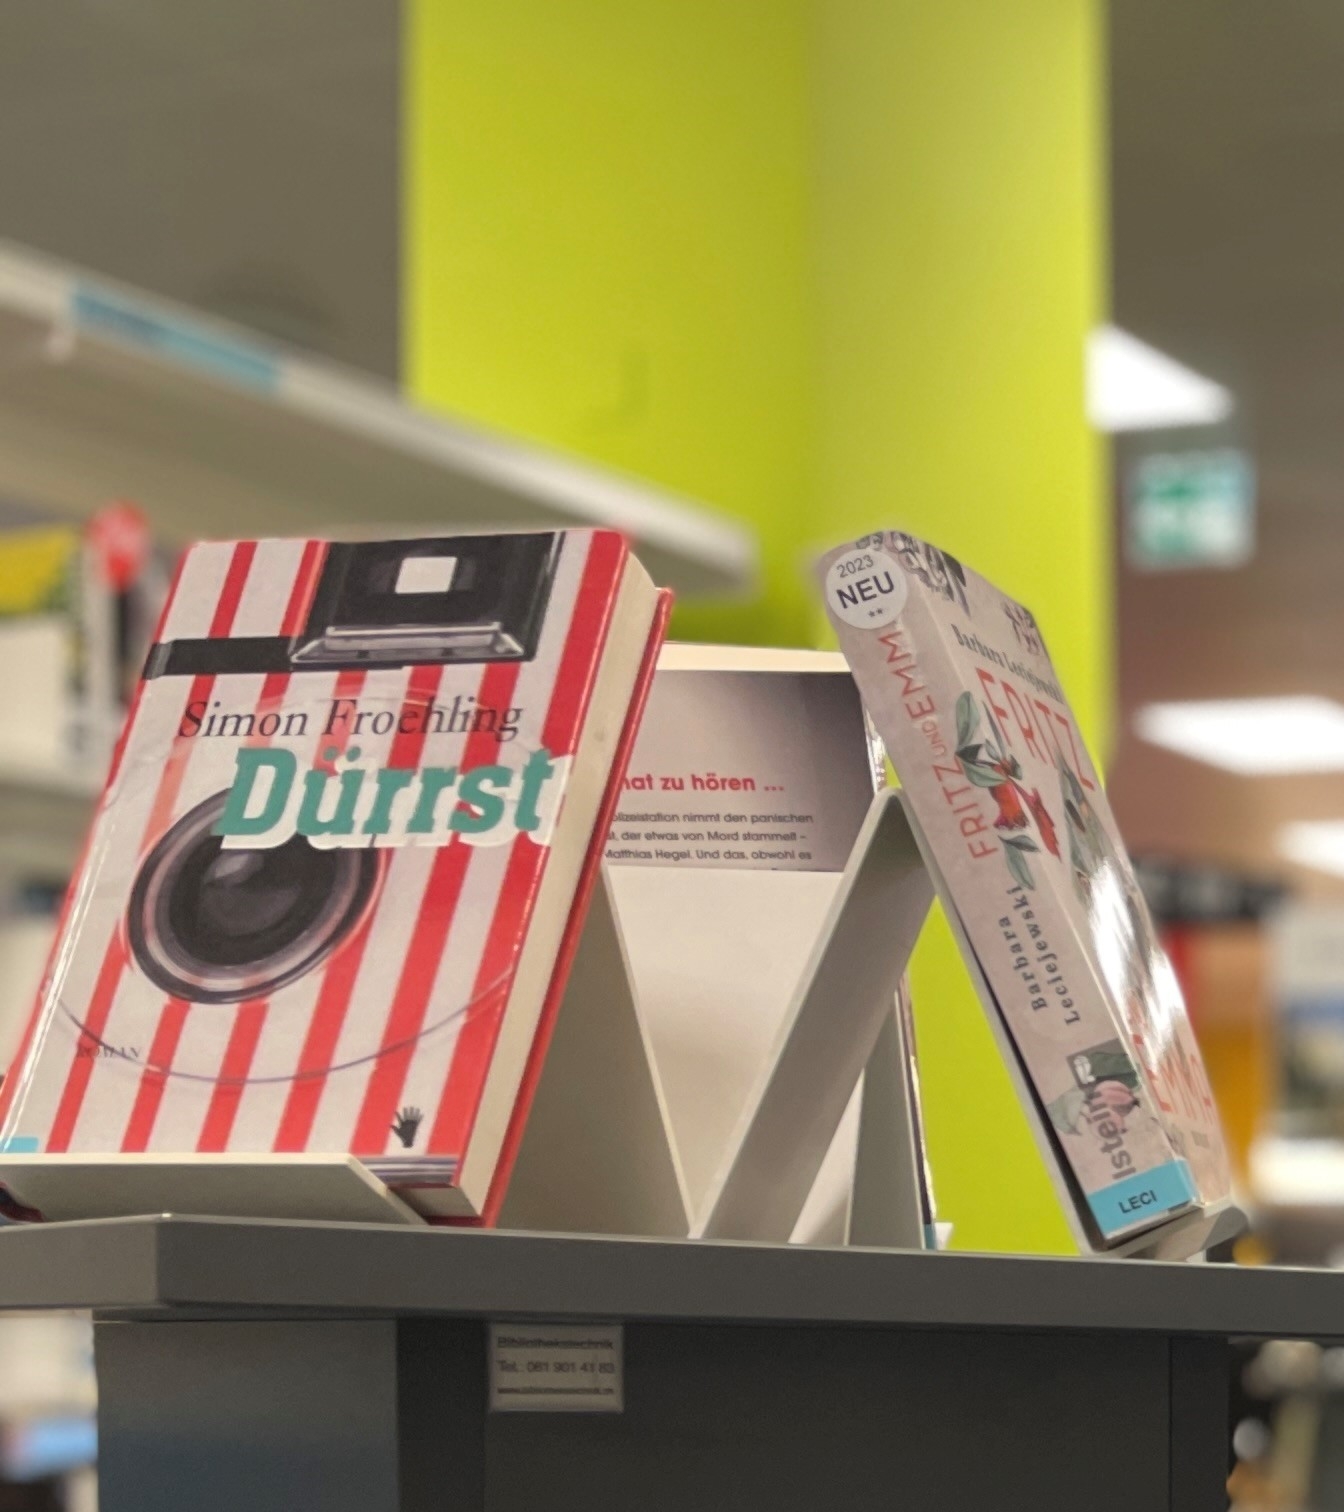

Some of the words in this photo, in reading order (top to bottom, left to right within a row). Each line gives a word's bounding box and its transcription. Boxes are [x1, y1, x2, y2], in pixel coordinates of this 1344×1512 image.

[836, 554, 874, 579] 2023
[836, 570, 895, 609] NEU
[178, 701, 316, 738] Simon
[321, 696, 524, 743] Froehling
[975, 667, 1096, 792] FRITZ
[211, 746, 555, 837] Dürrst
[661, 777, 684, 791] zu
[692, 773, 757, 791] hören
[683, 813, 720, 823] nimmt
[724, 813, 747, 823] den
[932, 757, 998, 860] FRITZ
[621, 832, 641, 841] der
[682, 833, 704, 841] von
[707, 832, 739, 841] Mord
[998, 916, 1049, 1012] Barbara
[1118, 1188, 1158, 1215] LECI
